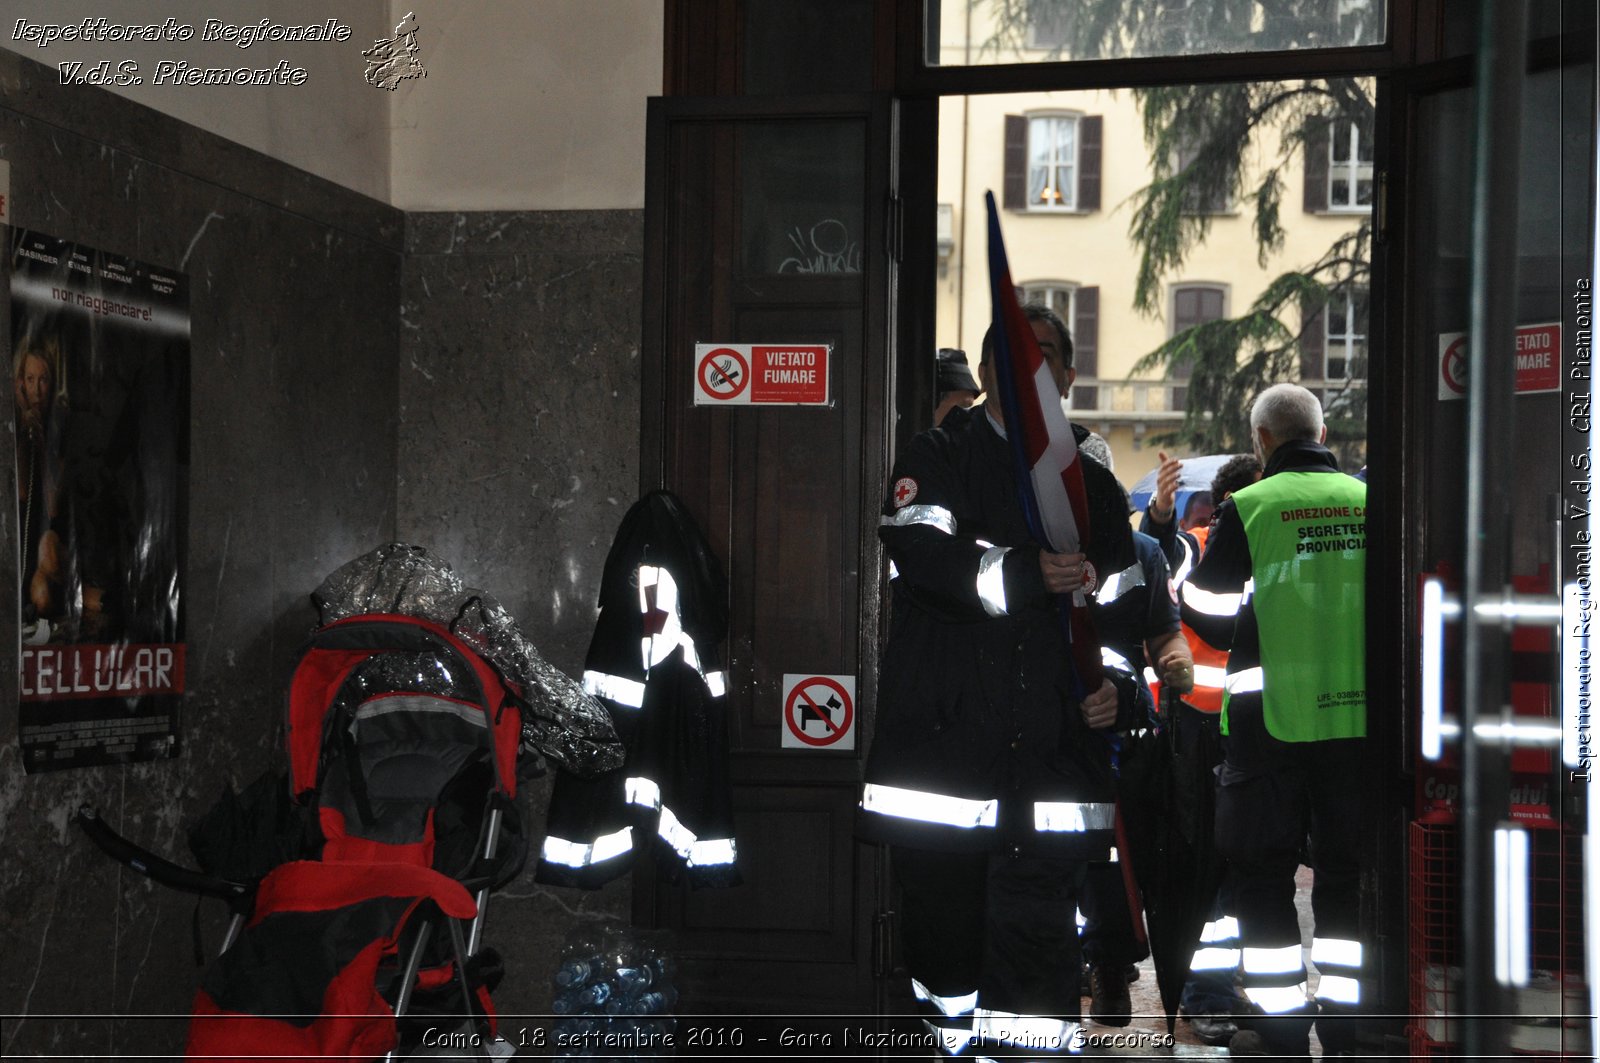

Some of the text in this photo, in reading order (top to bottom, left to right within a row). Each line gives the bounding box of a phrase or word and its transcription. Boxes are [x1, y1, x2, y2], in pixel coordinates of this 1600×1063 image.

[20, 248, 58, 265] BASINGER
[68, 261, 92, 274] EVANS
[52, 286, 152, 321] non riagganciare!
[766, 351, 815, 366] VIETATO
[1514, 352, 1551, 371] MARE
[764, 369, 816, 384] FUMARE
[1281, 507, 1351, 521] DIREZIONE
[21, 648, 173, 695] CELLULAR
